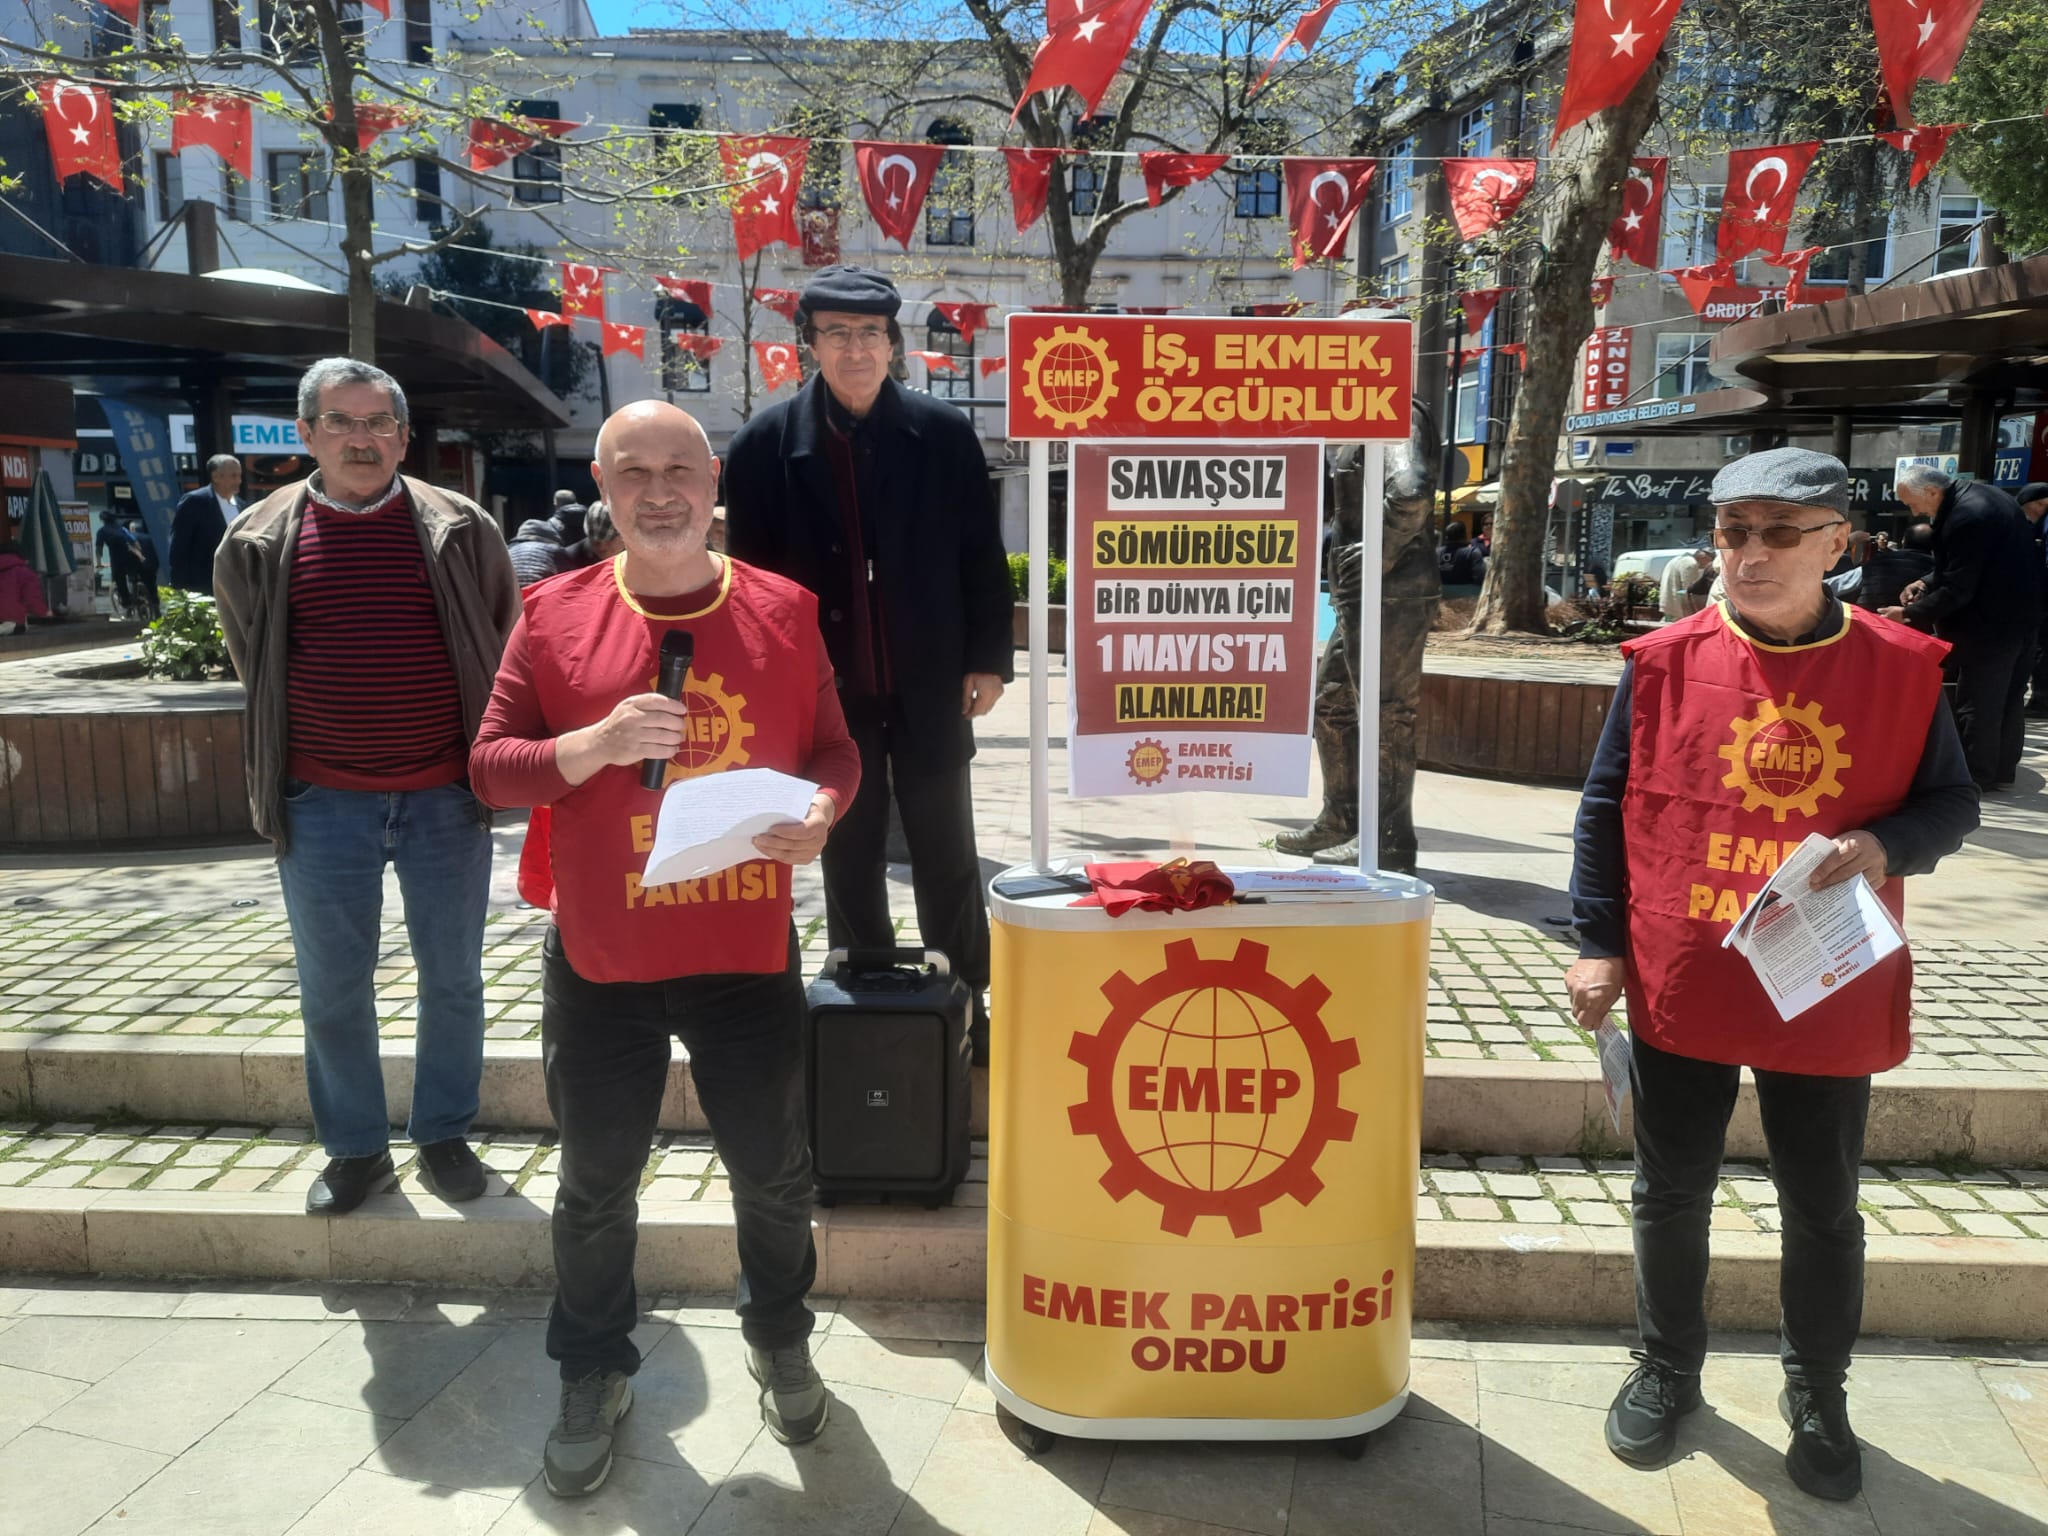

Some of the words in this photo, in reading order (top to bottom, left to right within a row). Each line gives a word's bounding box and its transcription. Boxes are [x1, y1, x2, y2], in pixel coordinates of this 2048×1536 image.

[1705, 303, 1745, 318] ORDU
[1142, 325, 1200, 377] İŞ,
[1215, 334, 1393, 377] EKMEK,
[1042, 369, 1100, 387] EMEP
[1135, 378, 1398, 422] ÖZGÜRLÜK
[1111, 459, 1284, 507] SAVAŞSIZ
[1601, 475, 1628, 500] The
[1096, 524, 1294, 565] SÖMÜRÜSÜZ
[1096, 582, 1140, 614] BİR
[1147, 582, 1231, 614] DÜNYA
[1237, 582, 1291, 619] İÇİN
[1096, 634, 1113, 672] 1
[1122, 633, 1287, 673] MAYIS'TA
[1119, 686, 1263, 720] ALANLARA!
[1136, 758, 1162, 768] EMEP
[1178, 743, 1232, 758] EMEK
[1750, 742, 1824, 773] EMEP
[1128, 1065, 1301, 1115] EMEP
[1023, 1273, 1171, 1331] EMEK
[1131, 1336, 1287, 1374] ORDU
